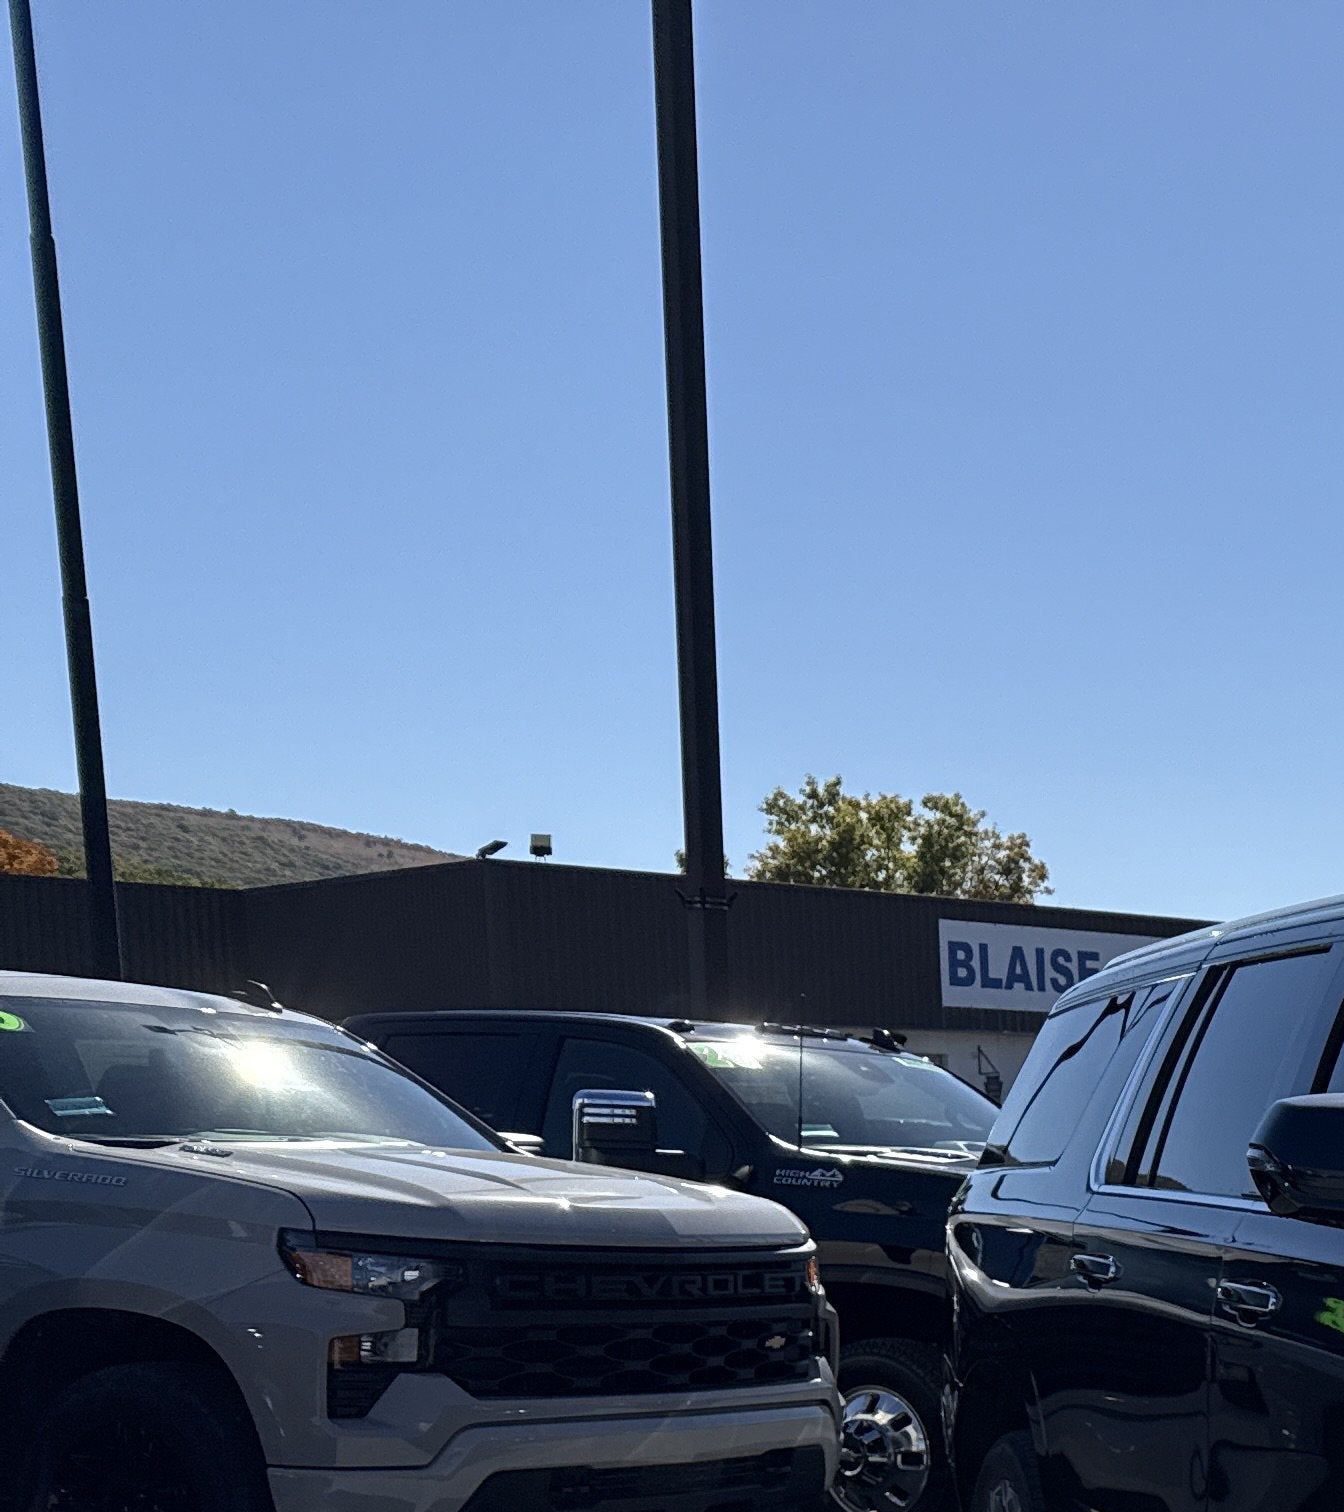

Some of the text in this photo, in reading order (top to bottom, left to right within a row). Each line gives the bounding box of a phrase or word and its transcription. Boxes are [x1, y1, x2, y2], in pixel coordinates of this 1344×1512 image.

[947, 940, 1100, 994] BLAISE
[13, 1166, 128, 1187] SILVERADO
[773, 1176, 840, 1188] COUNTRY
[775, 1168, 810, 1178] HIGH
[500, 1270, 805, 1299] CHEVROLET
